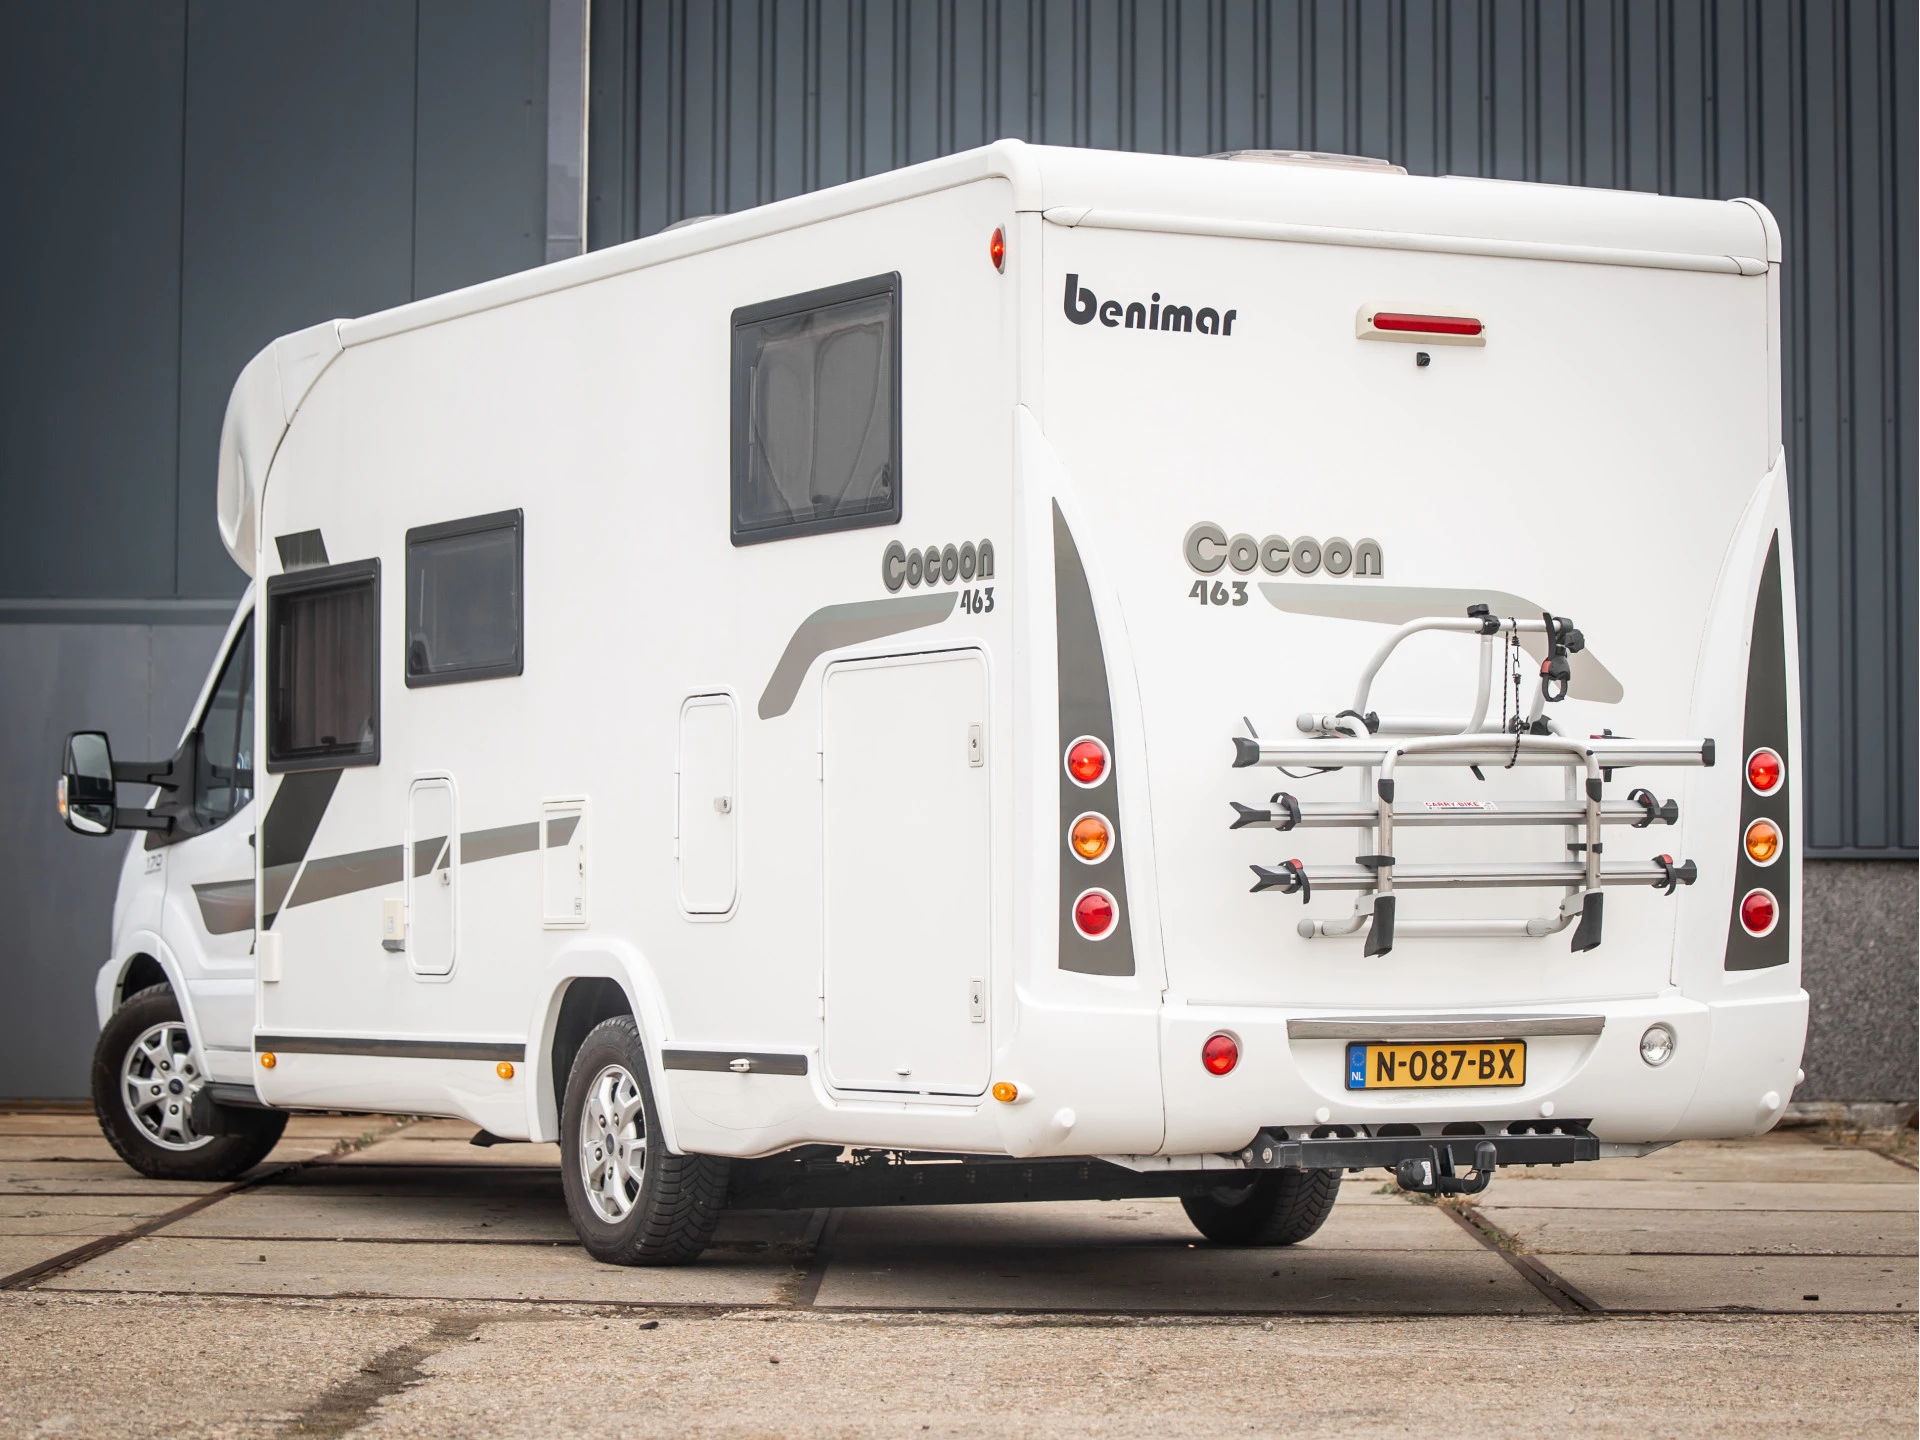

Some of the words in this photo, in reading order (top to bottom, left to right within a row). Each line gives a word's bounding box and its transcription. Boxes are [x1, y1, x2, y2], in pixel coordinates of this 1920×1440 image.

[1064, 273, 1237, 336] benimar
[882, 538, 995, 594] Cocoon
[1183, 521, 1384, 579] Cocoon
[960, 587, 995, 615] 463
[1189, 580, 1249, 606] 463
[1352, 1071, 1364, 1081] NL
[1376, 1048, 1517, 1082] N-087-BX
